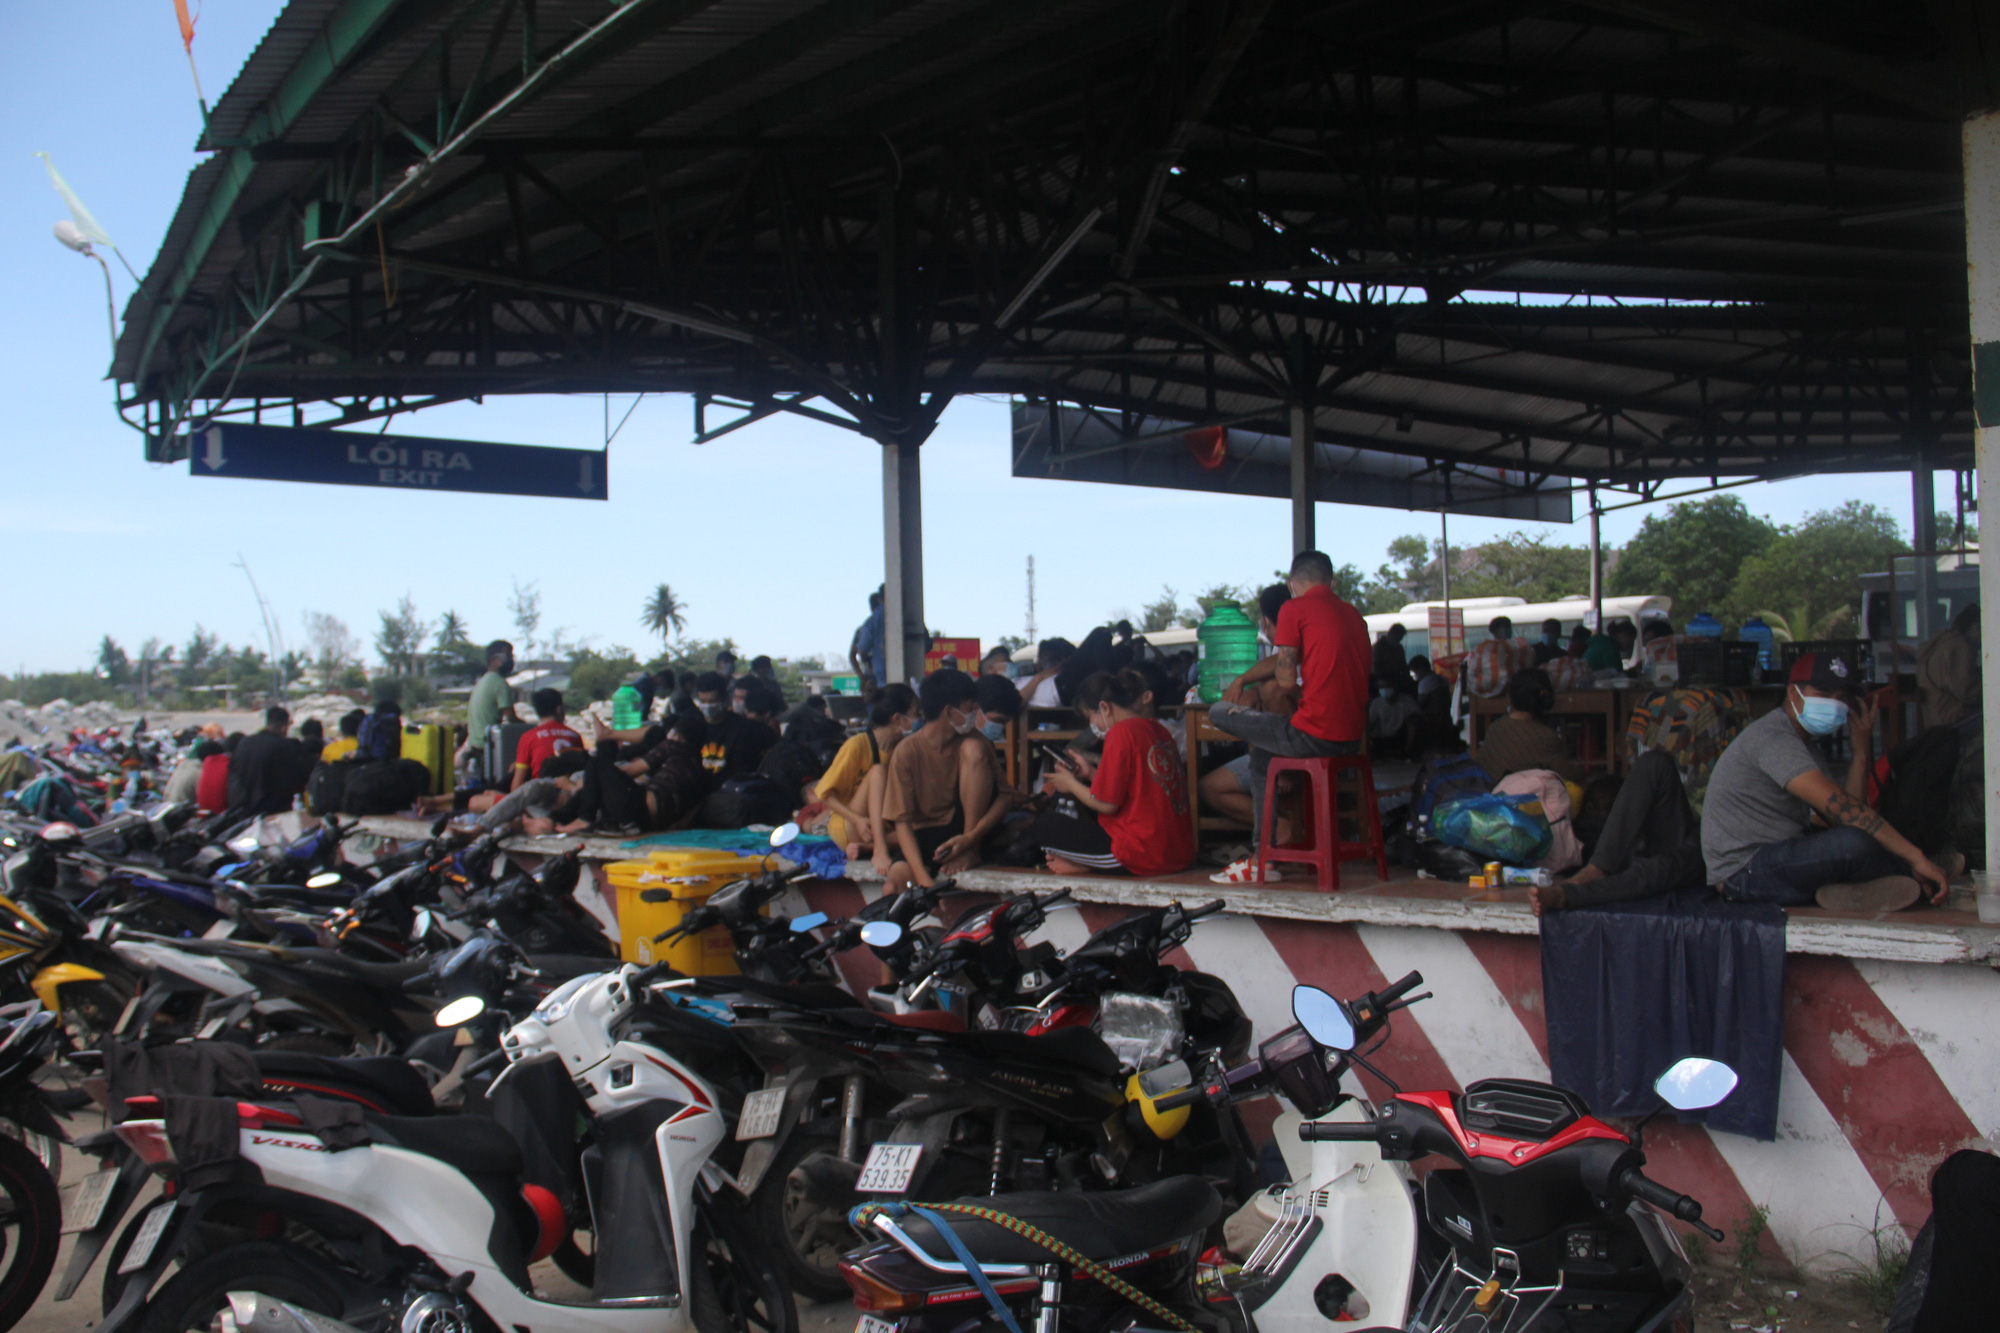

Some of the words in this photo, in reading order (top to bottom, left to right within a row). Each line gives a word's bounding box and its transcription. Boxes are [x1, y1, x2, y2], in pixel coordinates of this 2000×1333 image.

[347, 439, 408, 466] LỐI
[422, 449, 473, 471] RA
[379, 468, 443, 485] EXIT
[250, 1135, 326, 1152] VISIO
[670, 1134, 696, 1142] HONDA
[861, 1168, 909, 1189] 539.35
[1108, 1251, 1149, 1269] HONDA
